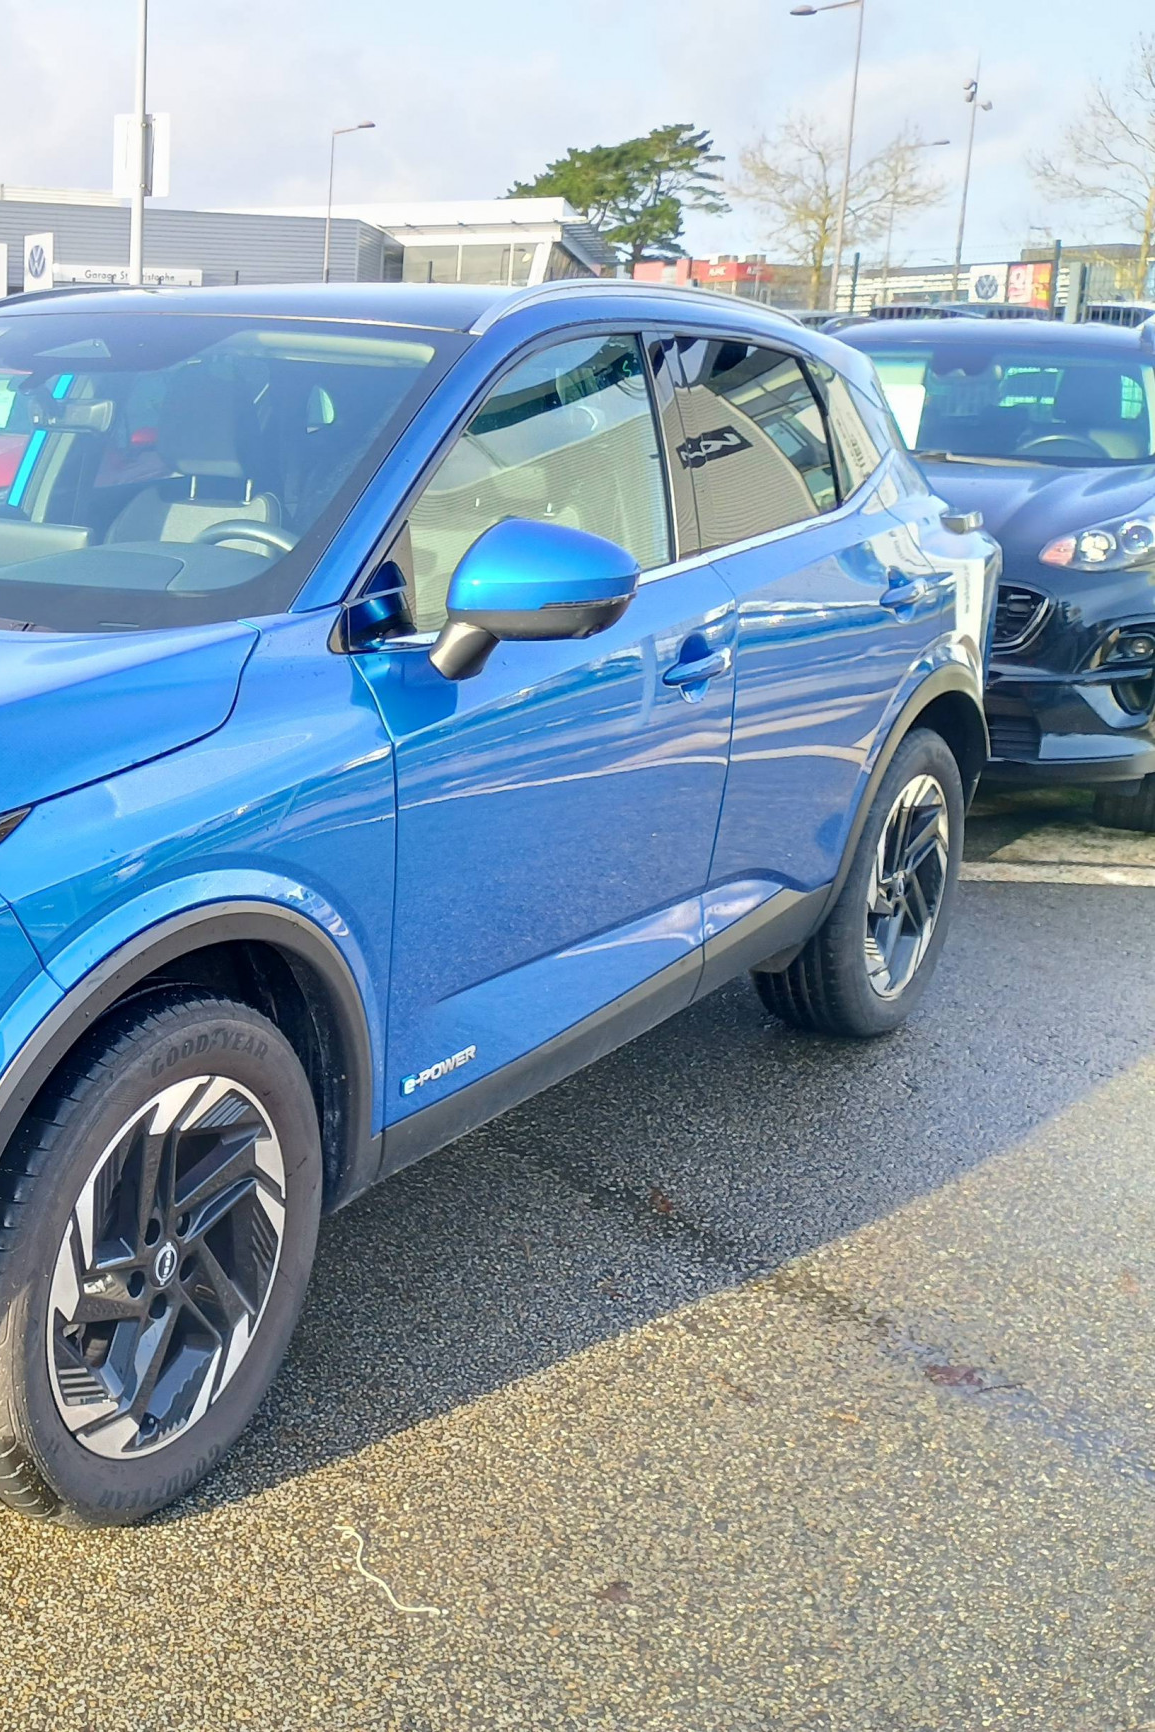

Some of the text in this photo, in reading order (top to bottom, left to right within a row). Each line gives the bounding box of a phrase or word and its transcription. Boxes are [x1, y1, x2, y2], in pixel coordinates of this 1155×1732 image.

[84, 269, 117, 281] Garage
[120, 270, 128, 280] St
[402, 1044, 477, 1095] e-POWER
